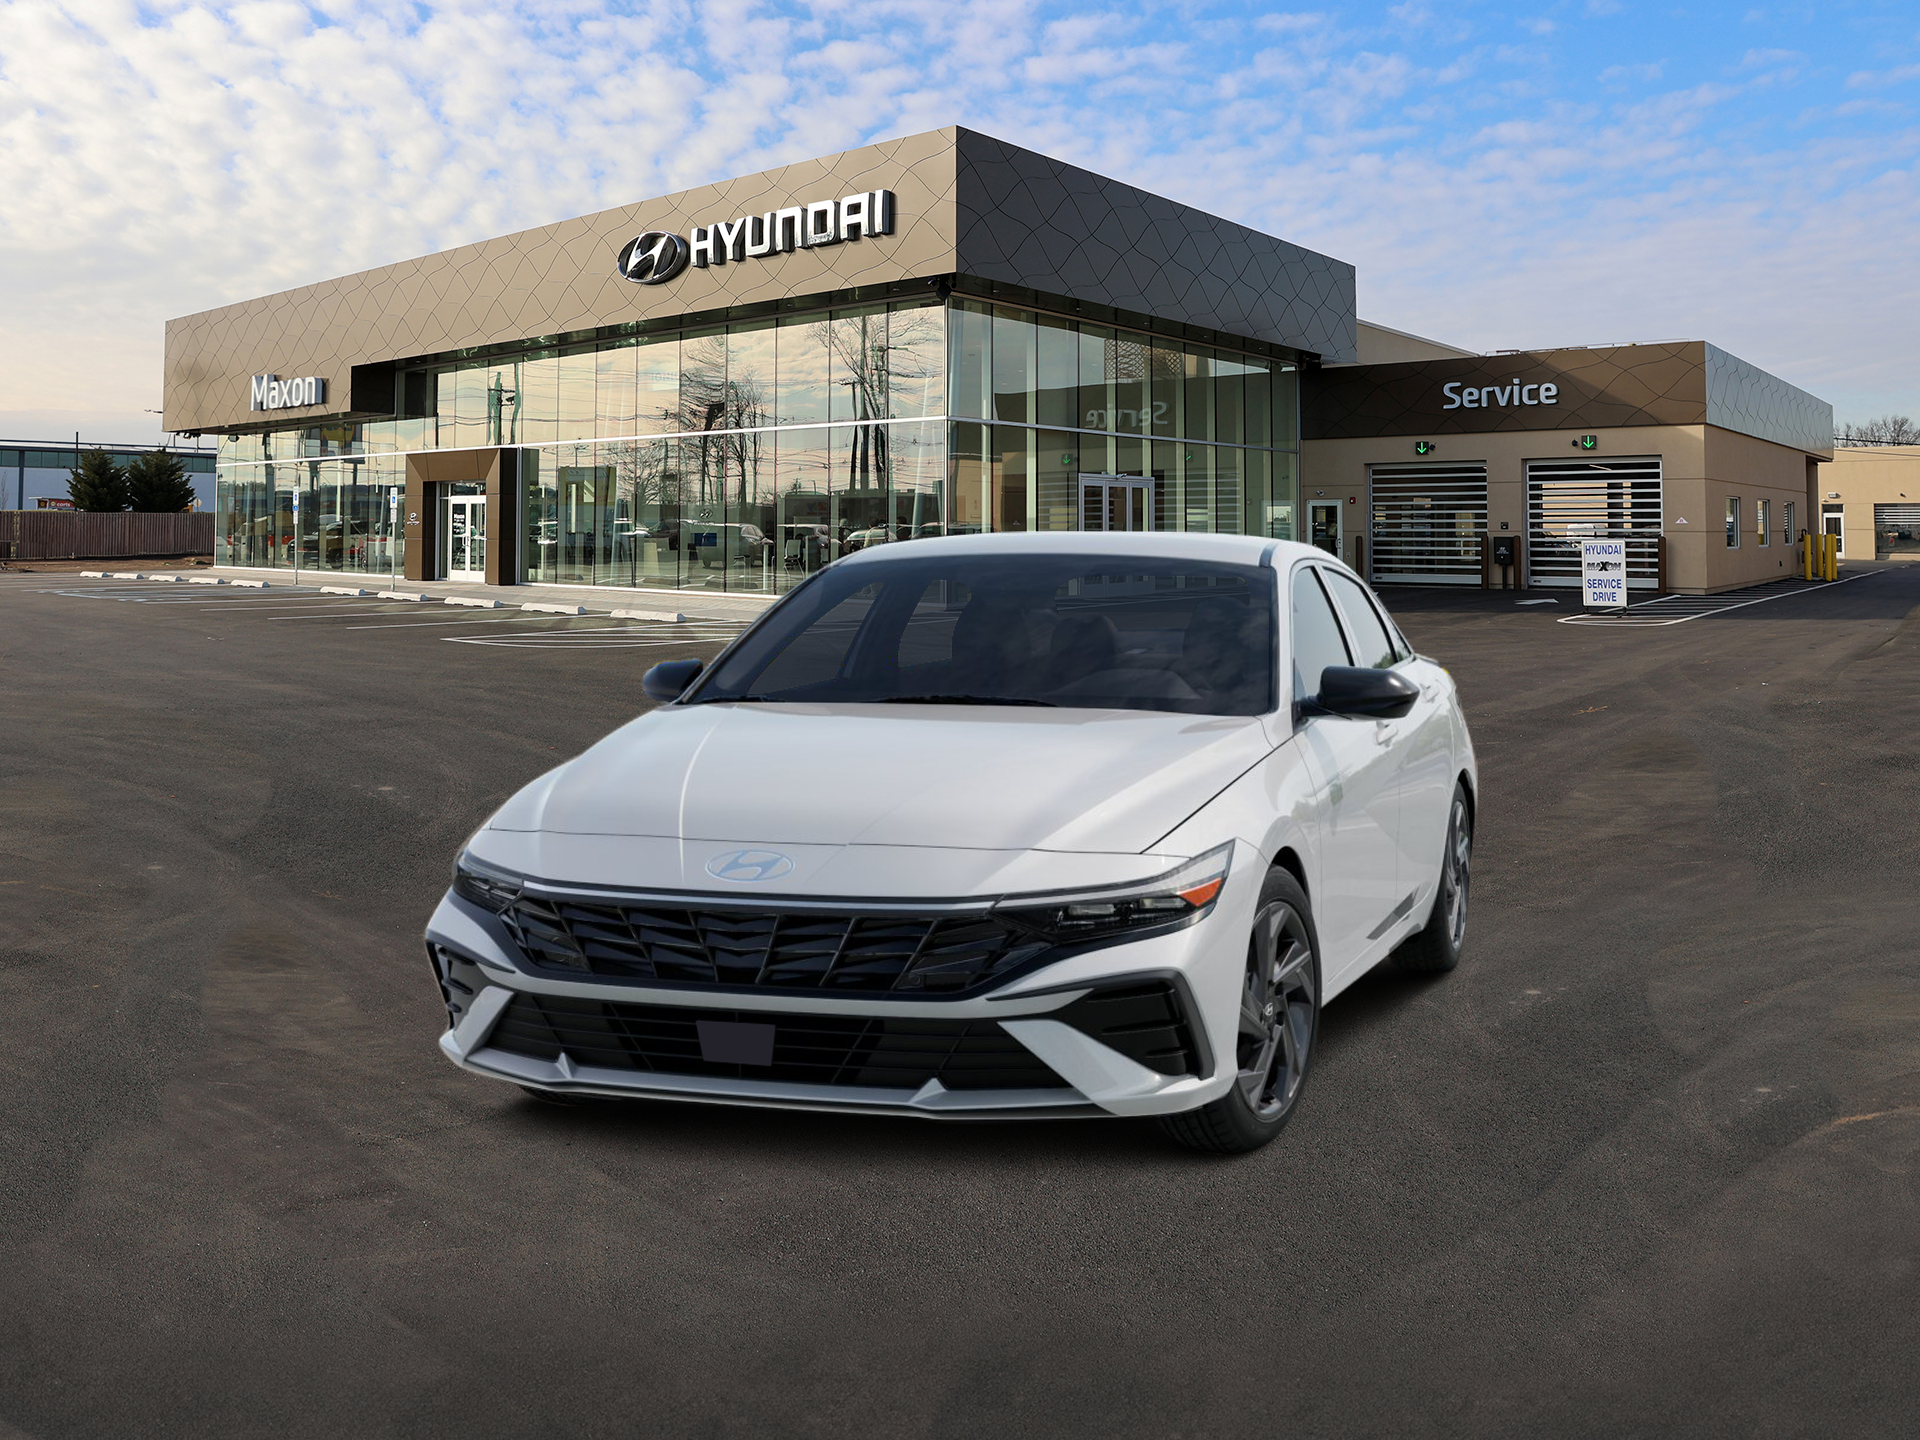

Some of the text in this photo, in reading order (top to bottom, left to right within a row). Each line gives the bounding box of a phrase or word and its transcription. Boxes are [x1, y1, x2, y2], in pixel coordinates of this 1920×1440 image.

[689, 189, 889, 268] HYUNDAI
[250, 374, 319, 411] Maxon
[1443, 378, 1558, 409] Service
[1585, 545, 1622, 555] HYUNDAI
[1586, 561, 1622, 572] MAXON
[1587, 579, 1622, 589] SERVICE
[1593, 592, 1617, 602] DRIVE
